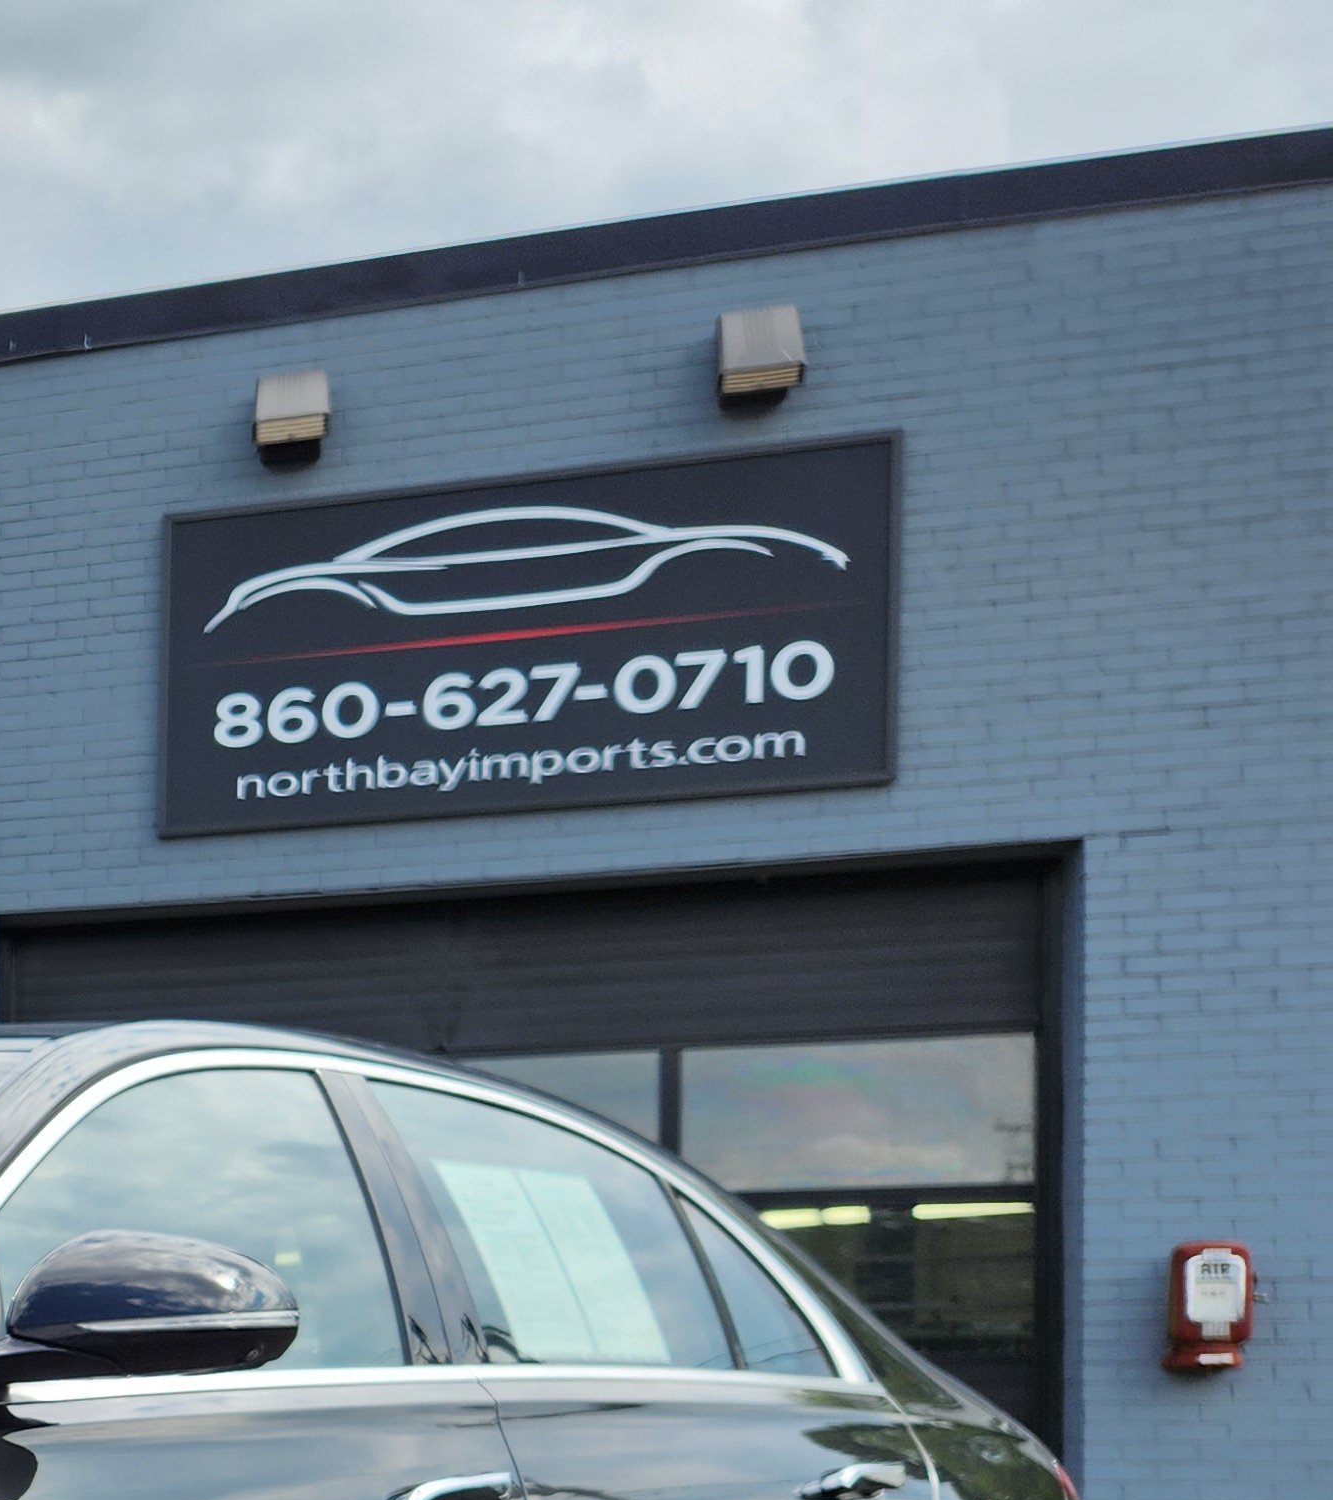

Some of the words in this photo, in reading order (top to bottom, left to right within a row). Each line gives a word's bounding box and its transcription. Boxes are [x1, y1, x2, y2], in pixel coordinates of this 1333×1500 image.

[213, 640, 835, 749] 860-627-0710
[236, 730, 807, 801] northbayimports.com
[1201, 1263, 1230, 1274] AIR
